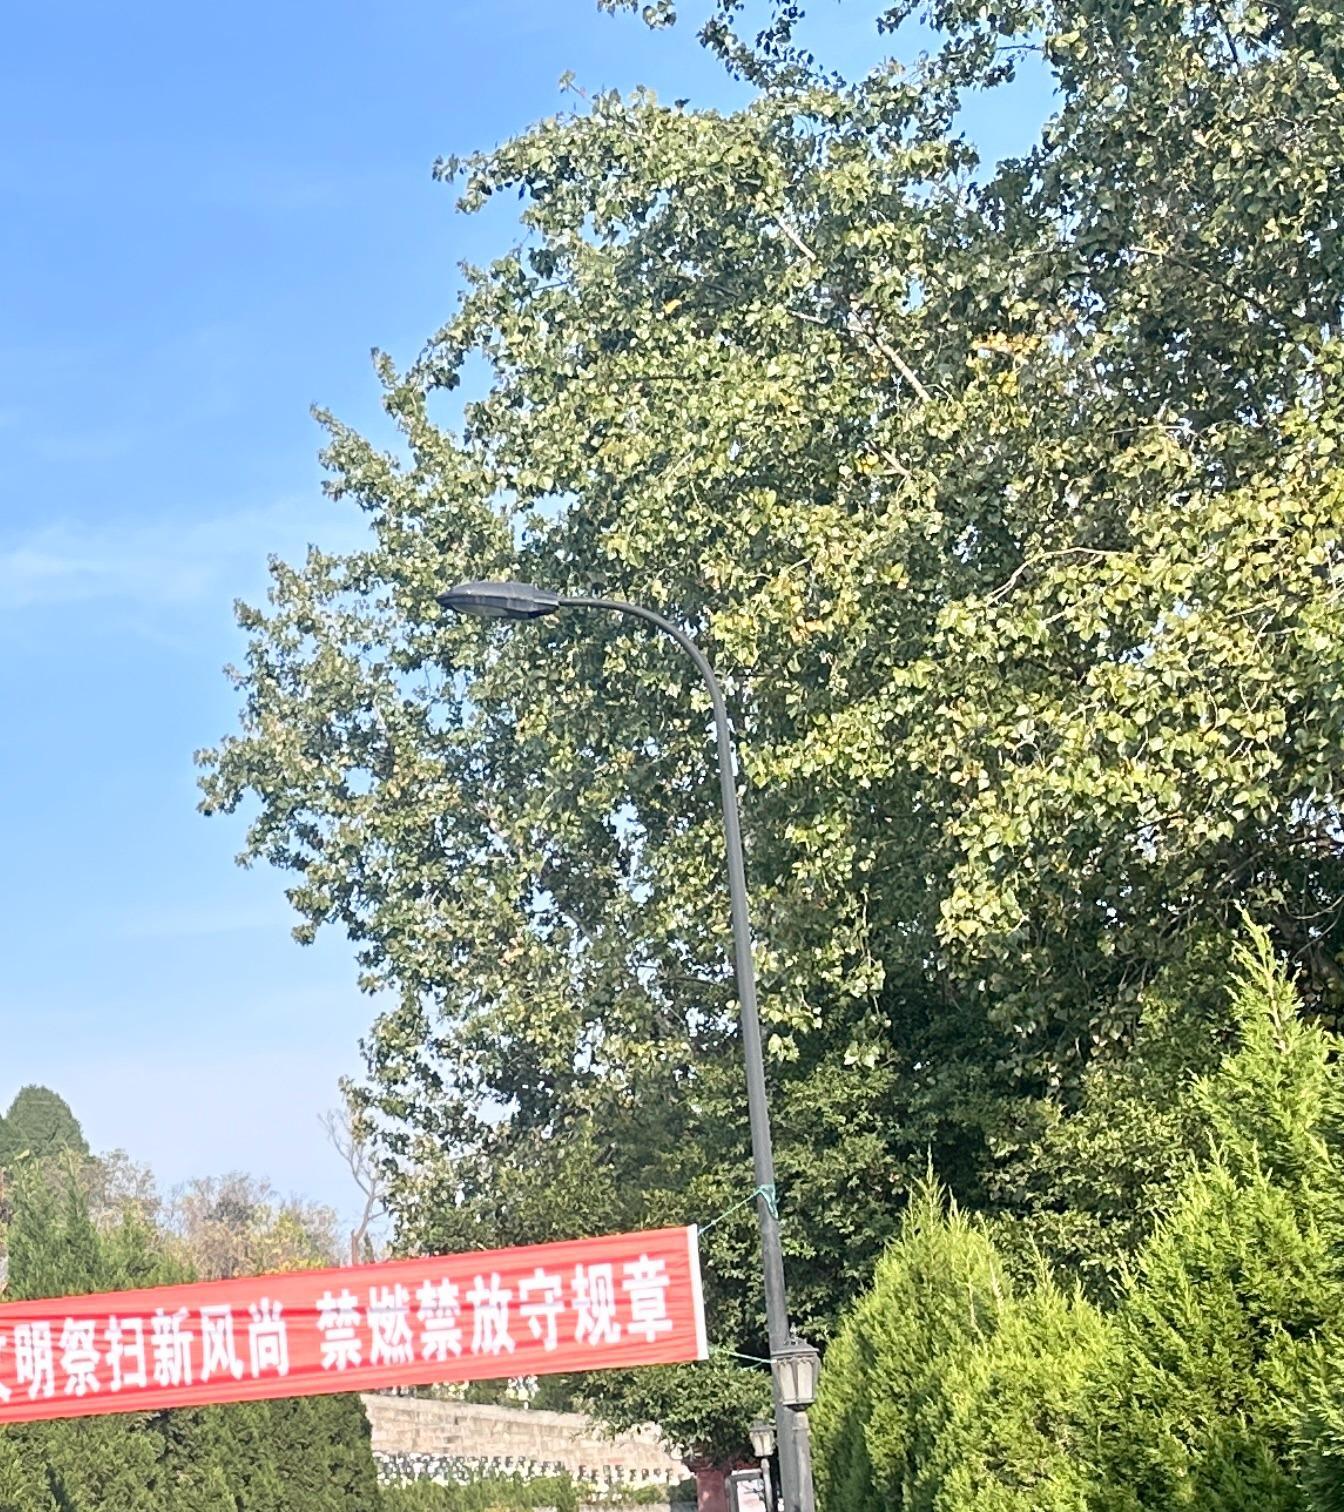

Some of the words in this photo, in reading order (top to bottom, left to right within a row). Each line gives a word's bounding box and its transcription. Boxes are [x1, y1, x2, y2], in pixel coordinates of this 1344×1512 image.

[315, 1254, 674, 1372] 禁燃禁放守规章
